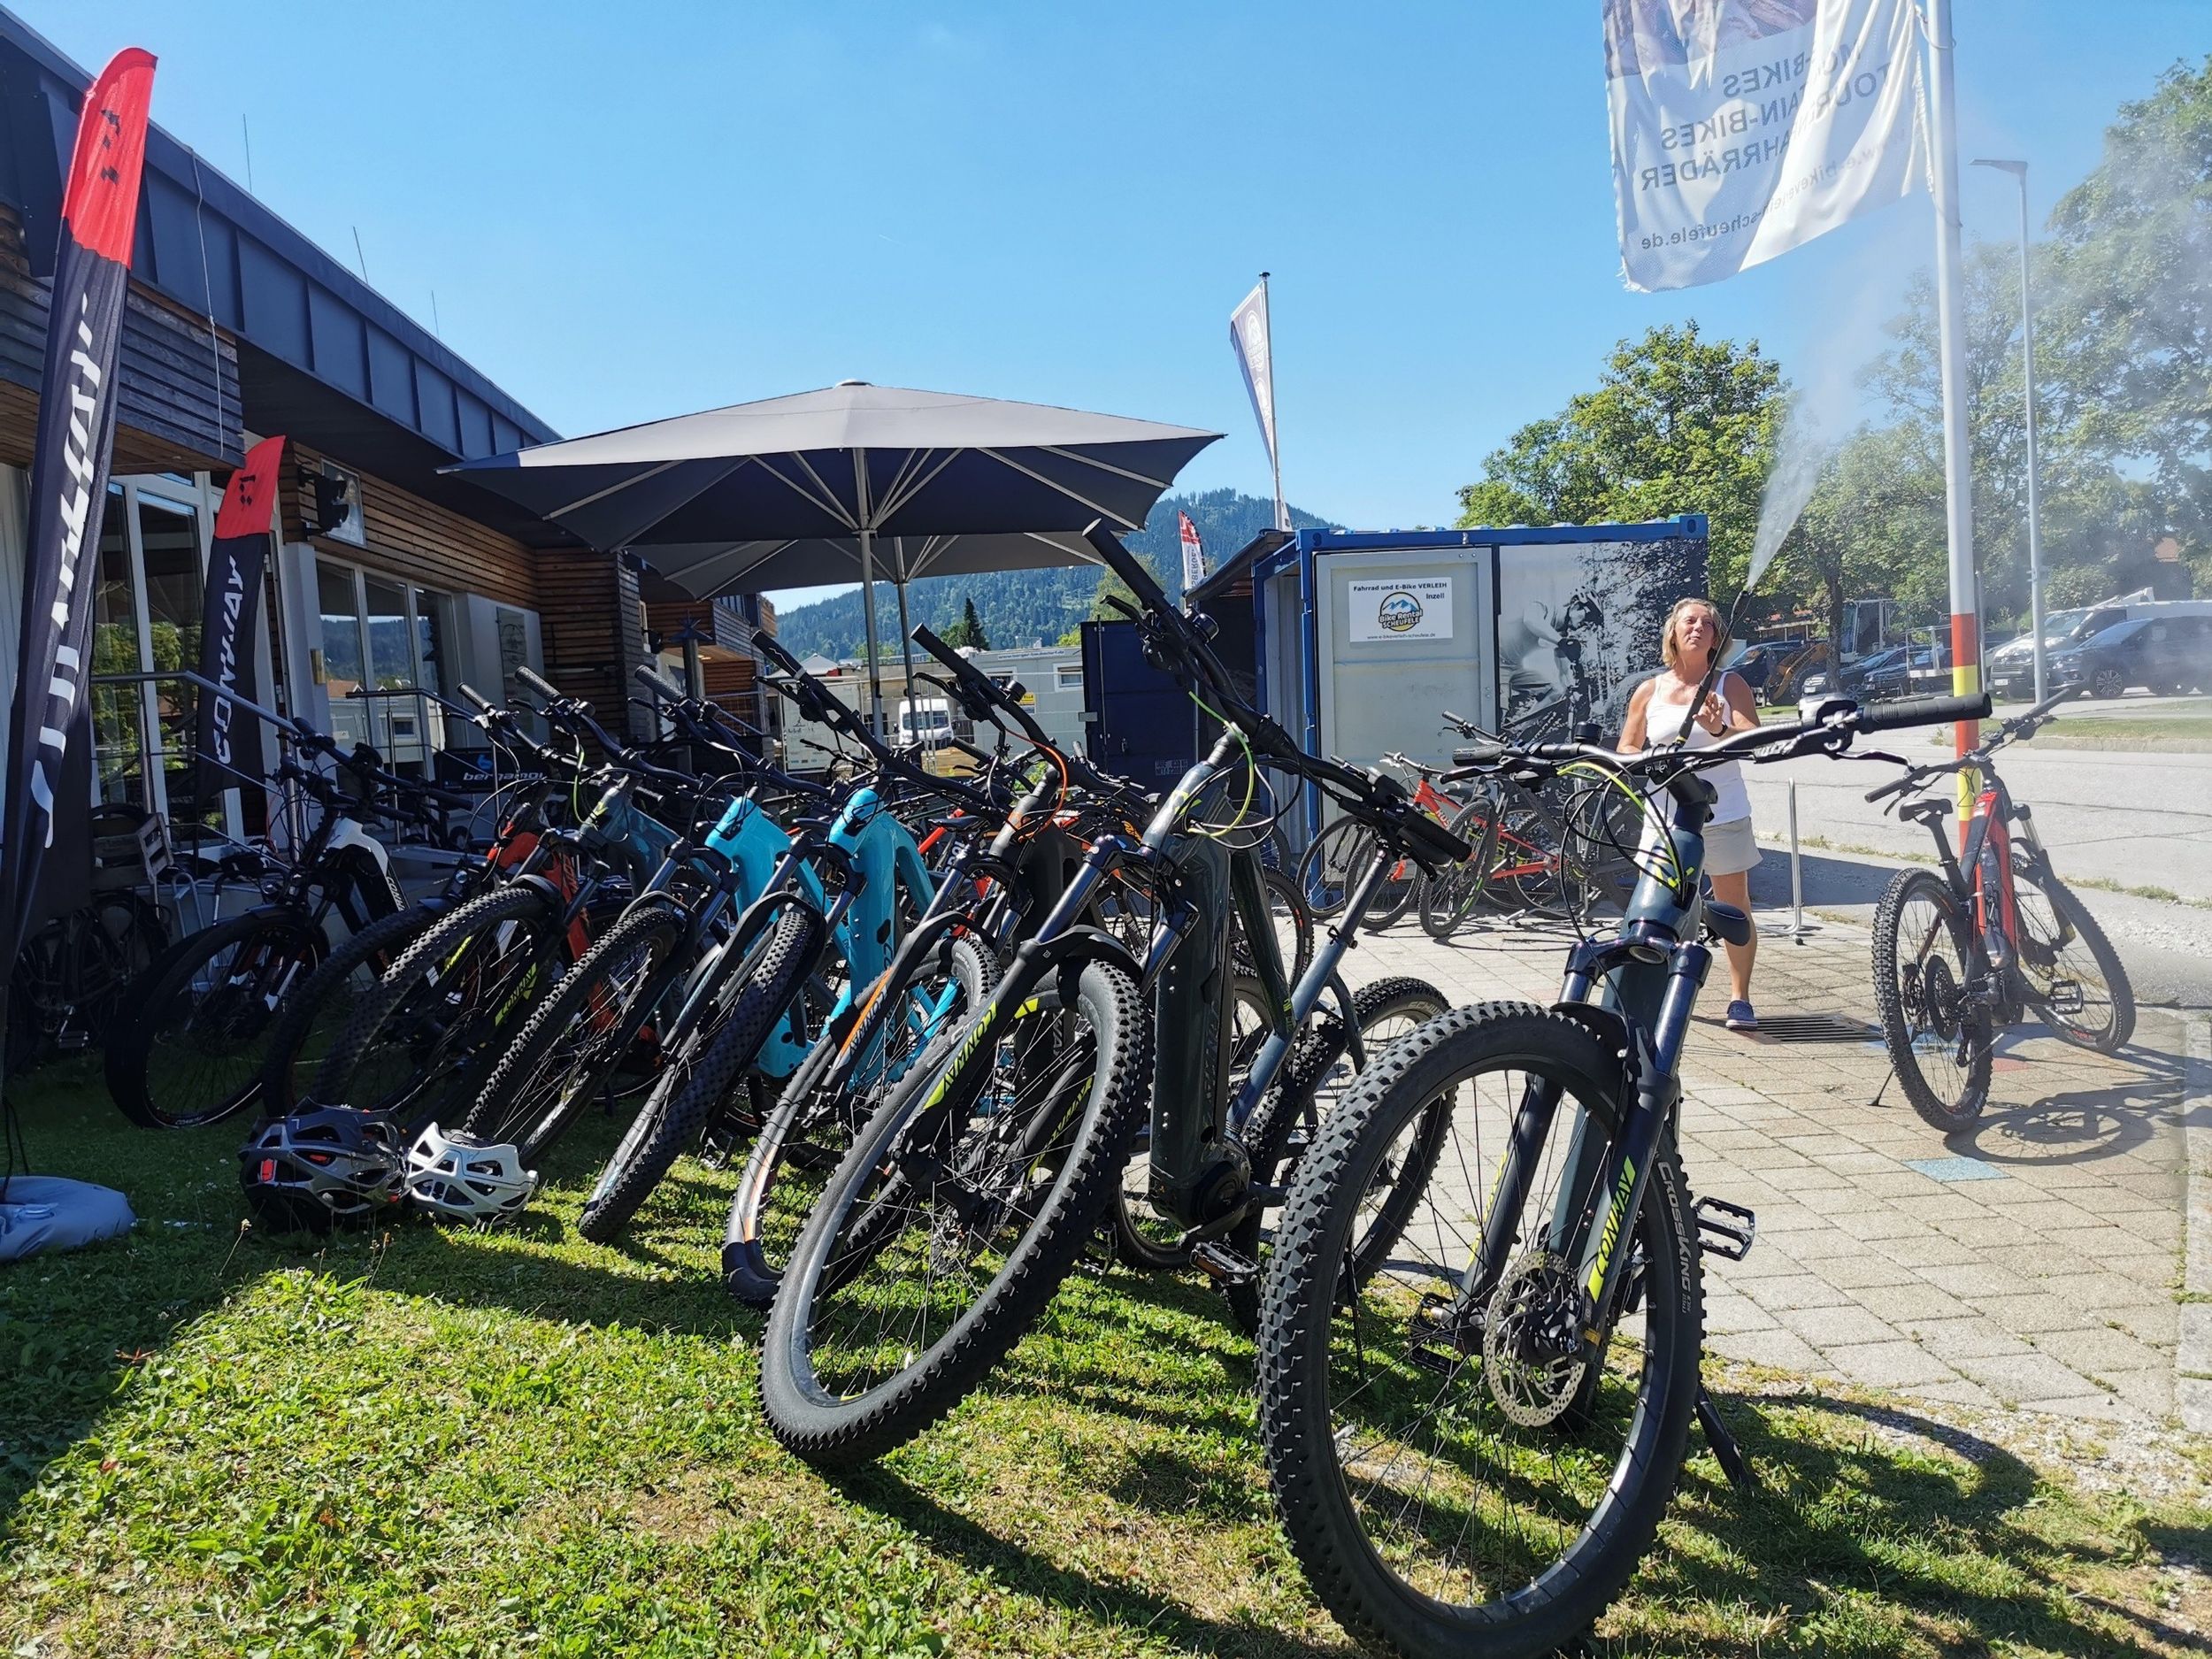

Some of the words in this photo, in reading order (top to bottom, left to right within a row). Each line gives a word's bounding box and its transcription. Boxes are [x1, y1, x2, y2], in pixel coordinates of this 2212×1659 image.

[1379, 613, 1398, 623] Bike
[1397, 608, 1423, 621] Rental
[1381, 617, 1420, 629] SCHEUFELE
[213, 555, 243, 764] CONWAY
[1595, 1173, 1633, 1278] CONWAY
